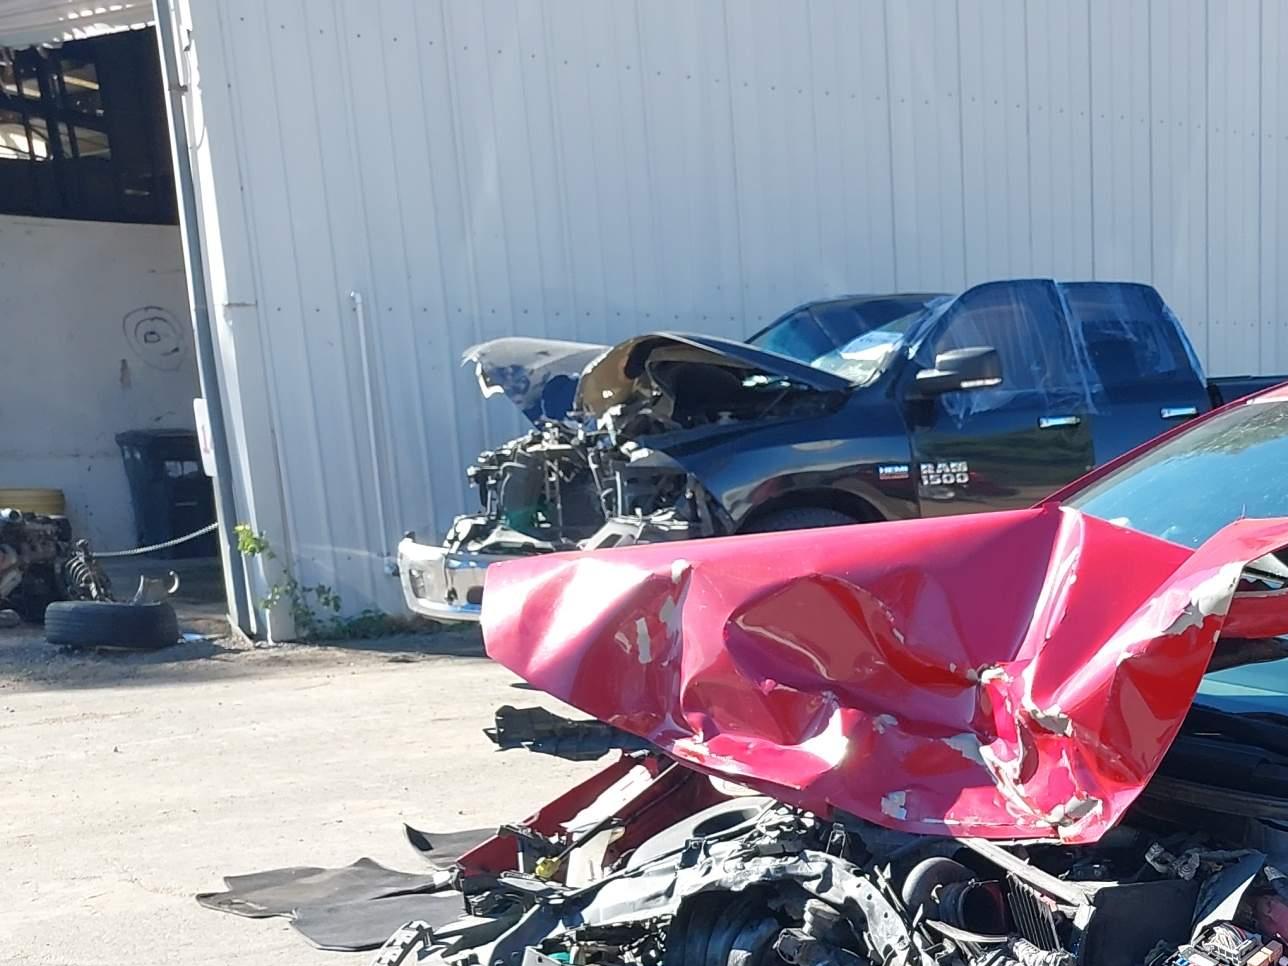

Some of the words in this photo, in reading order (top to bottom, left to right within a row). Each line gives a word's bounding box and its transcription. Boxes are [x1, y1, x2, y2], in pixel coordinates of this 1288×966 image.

[878, 465, 909, 475] HEMI
[920, 461, 968, 474] RAM
[920, 473, 969, 486] 1500
